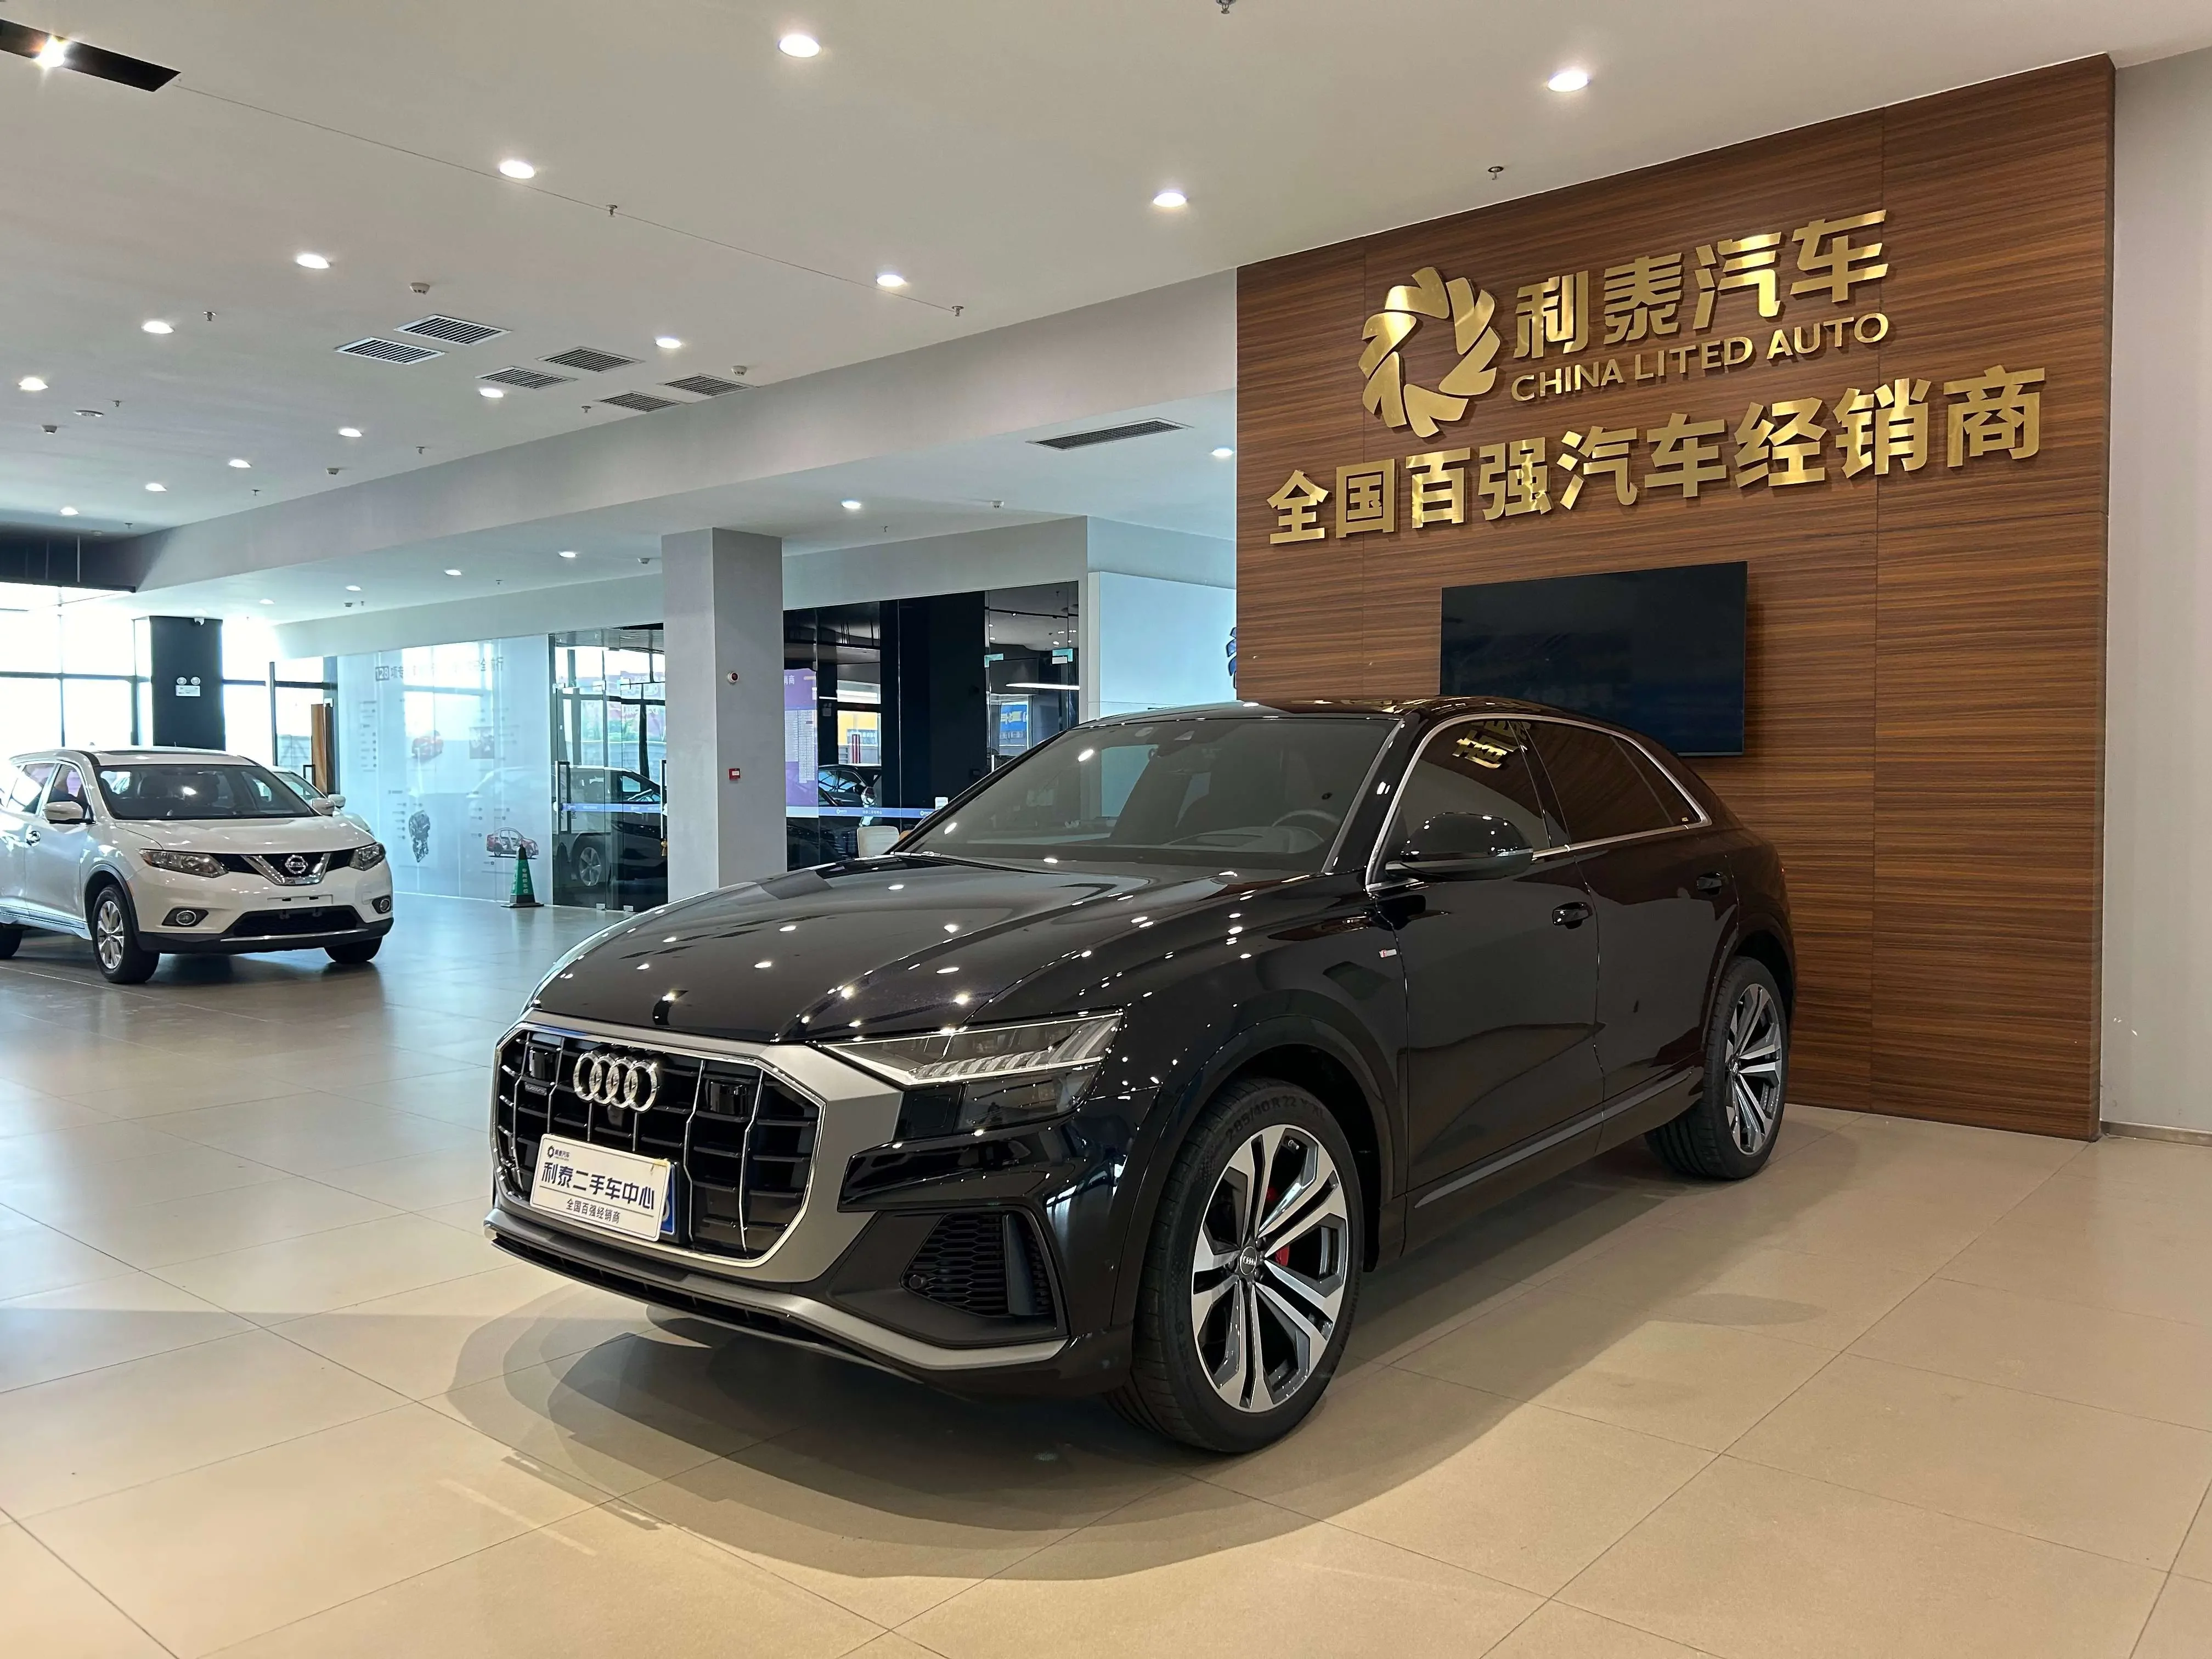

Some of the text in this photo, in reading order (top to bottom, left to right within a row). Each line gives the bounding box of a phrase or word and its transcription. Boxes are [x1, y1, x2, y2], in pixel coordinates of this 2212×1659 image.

[1514, 209, 1888, 359] 利泰汽车
[1511, 312, 1889, 402] CHINA LITED AUTO
[1267, 364, 2046, 545] 全国百强汽车经销商
[541, 1161, 655, 1210] 利泰二手车中心
[566, 1198, 620, 1224] 全国百强经销商
